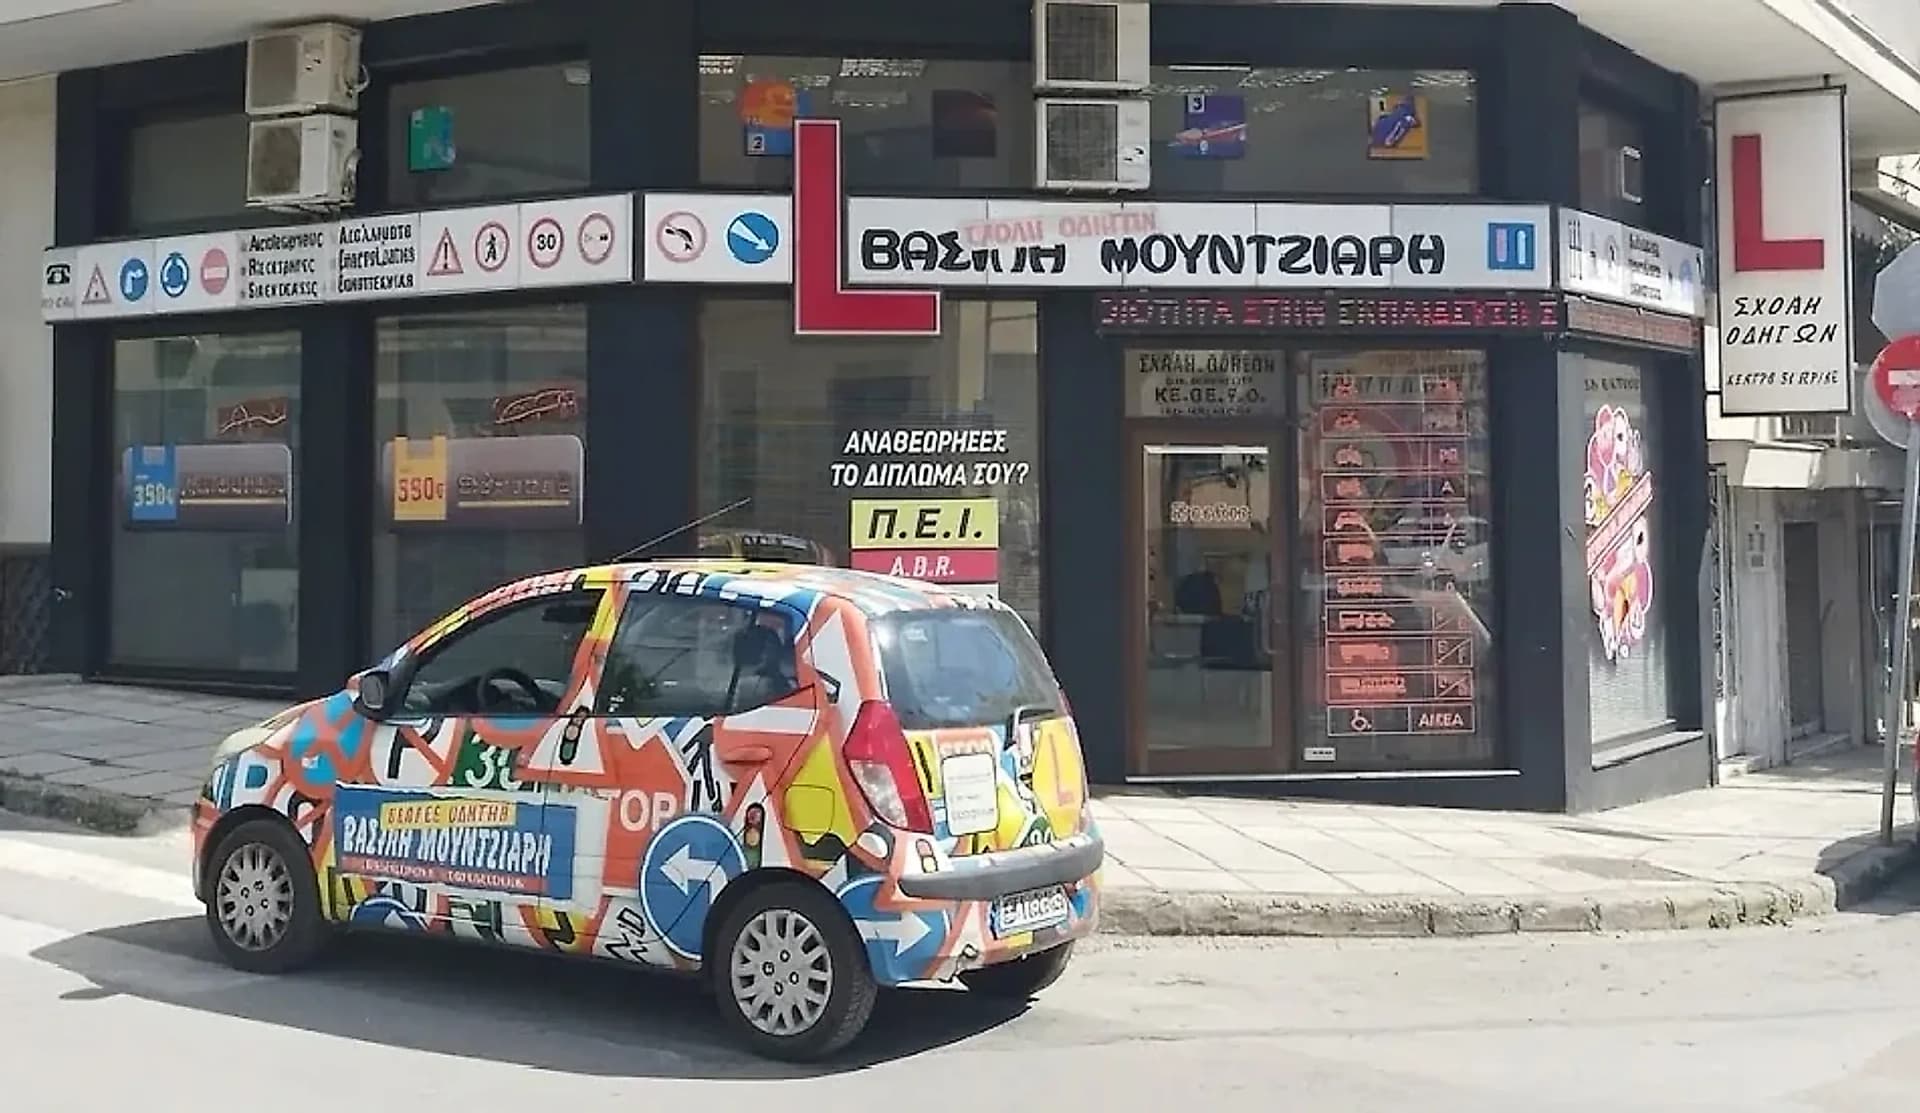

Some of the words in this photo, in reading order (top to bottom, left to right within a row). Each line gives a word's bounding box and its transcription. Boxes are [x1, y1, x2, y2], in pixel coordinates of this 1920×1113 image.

[1732, 134, 1824, 272] L
[536, 235, 557, 252] 30
[1099, 233, 1447, 277] ΜΟΥΝΤΖΙΑΡΗ
[831, 463, 858, 487] ΤΟ
[863, 463, 967, 487] ΔΙΠΛΩΜΑ
